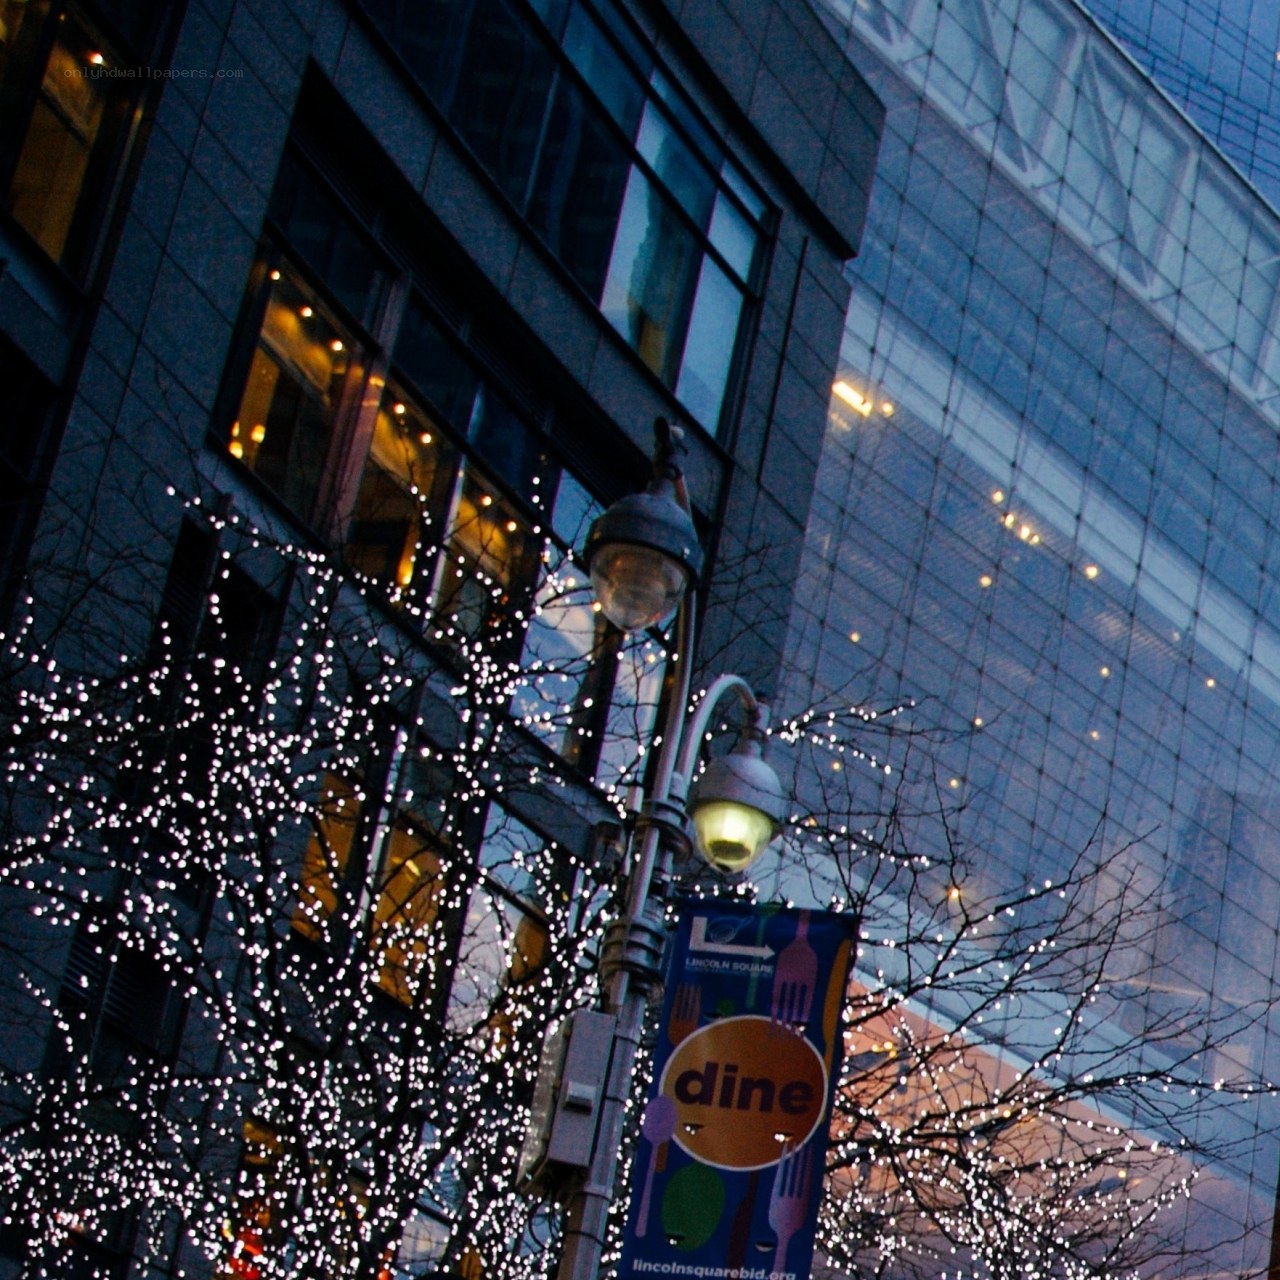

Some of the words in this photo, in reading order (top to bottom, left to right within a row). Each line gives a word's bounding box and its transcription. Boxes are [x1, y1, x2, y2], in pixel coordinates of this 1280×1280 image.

[685, 957, 731, 970] LINCOLN
[732, 961, 775, 974] SQUARE
[675, 1061, 814, 1114] dine
